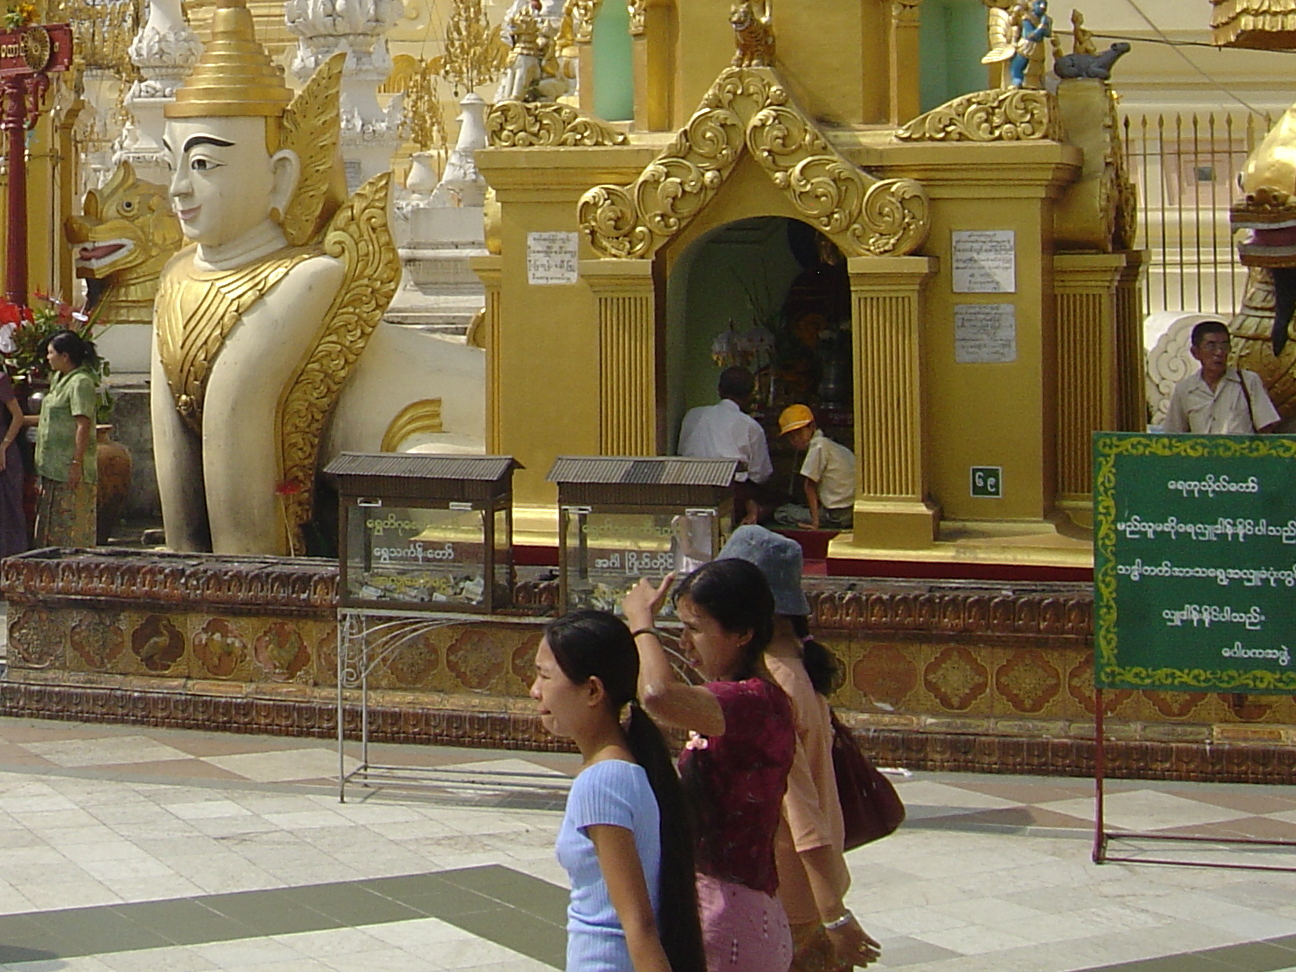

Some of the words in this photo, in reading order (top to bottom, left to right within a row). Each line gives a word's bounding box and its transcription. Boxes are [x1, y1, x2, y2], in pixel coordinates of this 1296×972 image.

[1167, 473, 1259, 498] ရေကုသိုလ်တော်
[1221, 641, 1291, 666] ဂေါပကအဖွဲ့
